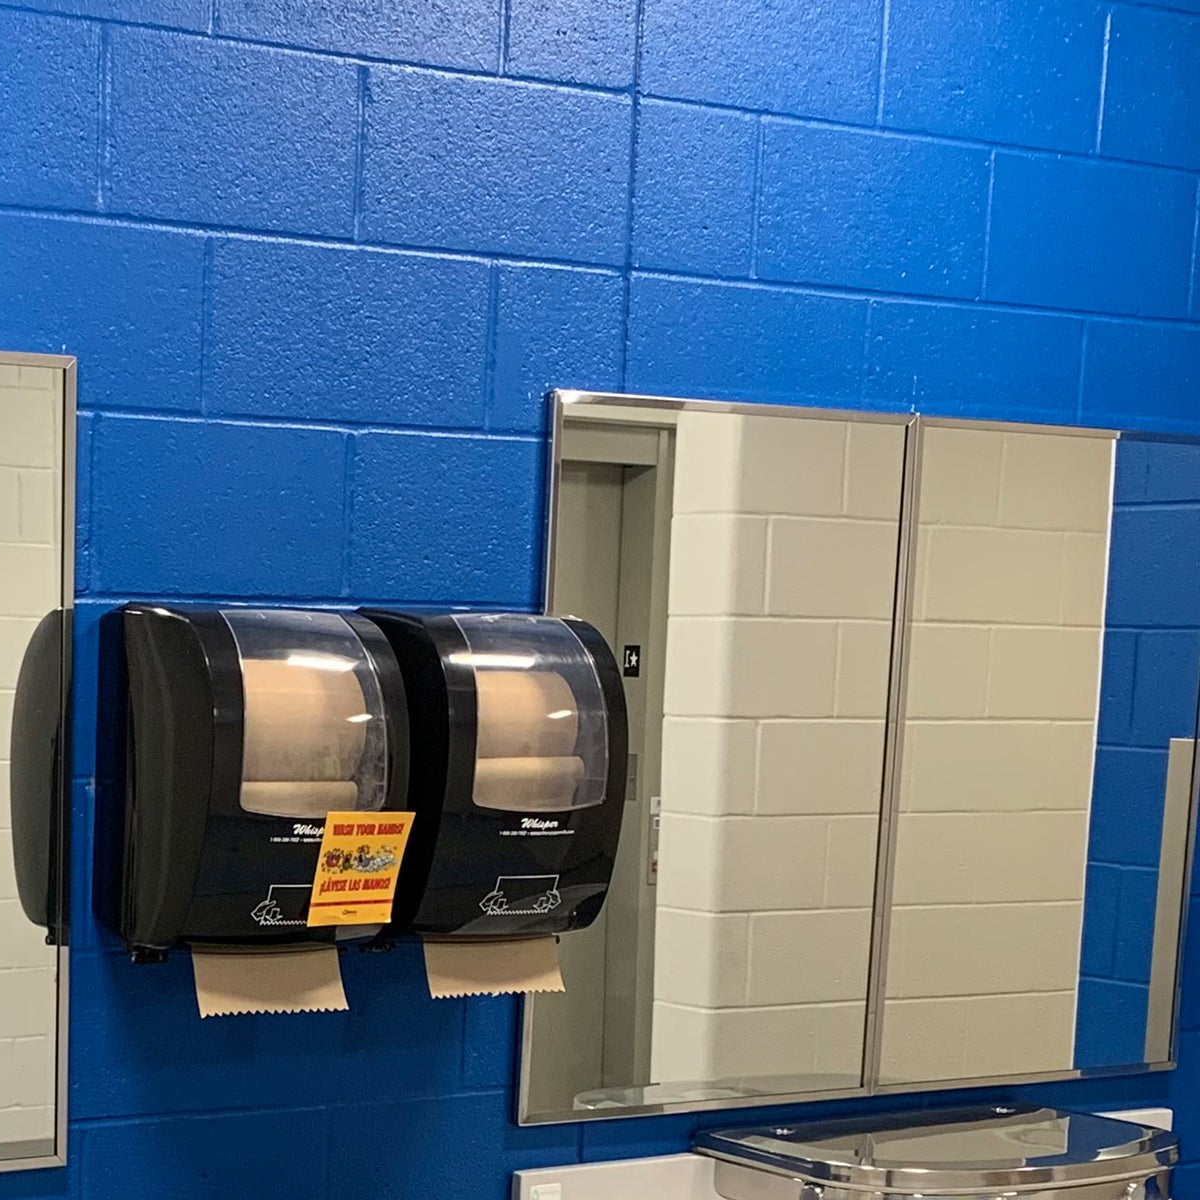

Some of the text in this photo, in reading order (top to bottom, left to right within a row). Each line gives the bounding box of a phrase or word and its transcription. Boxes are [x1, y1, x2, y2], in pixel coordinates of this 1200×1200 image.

[293, 823, 324, 837] Whisp
[333, 823, 355, 836] WASH
[356, 823, 376, 836] YOUR
[520, 817, 559, 831] Whisper
[348, 878, 362, 891] LAS
